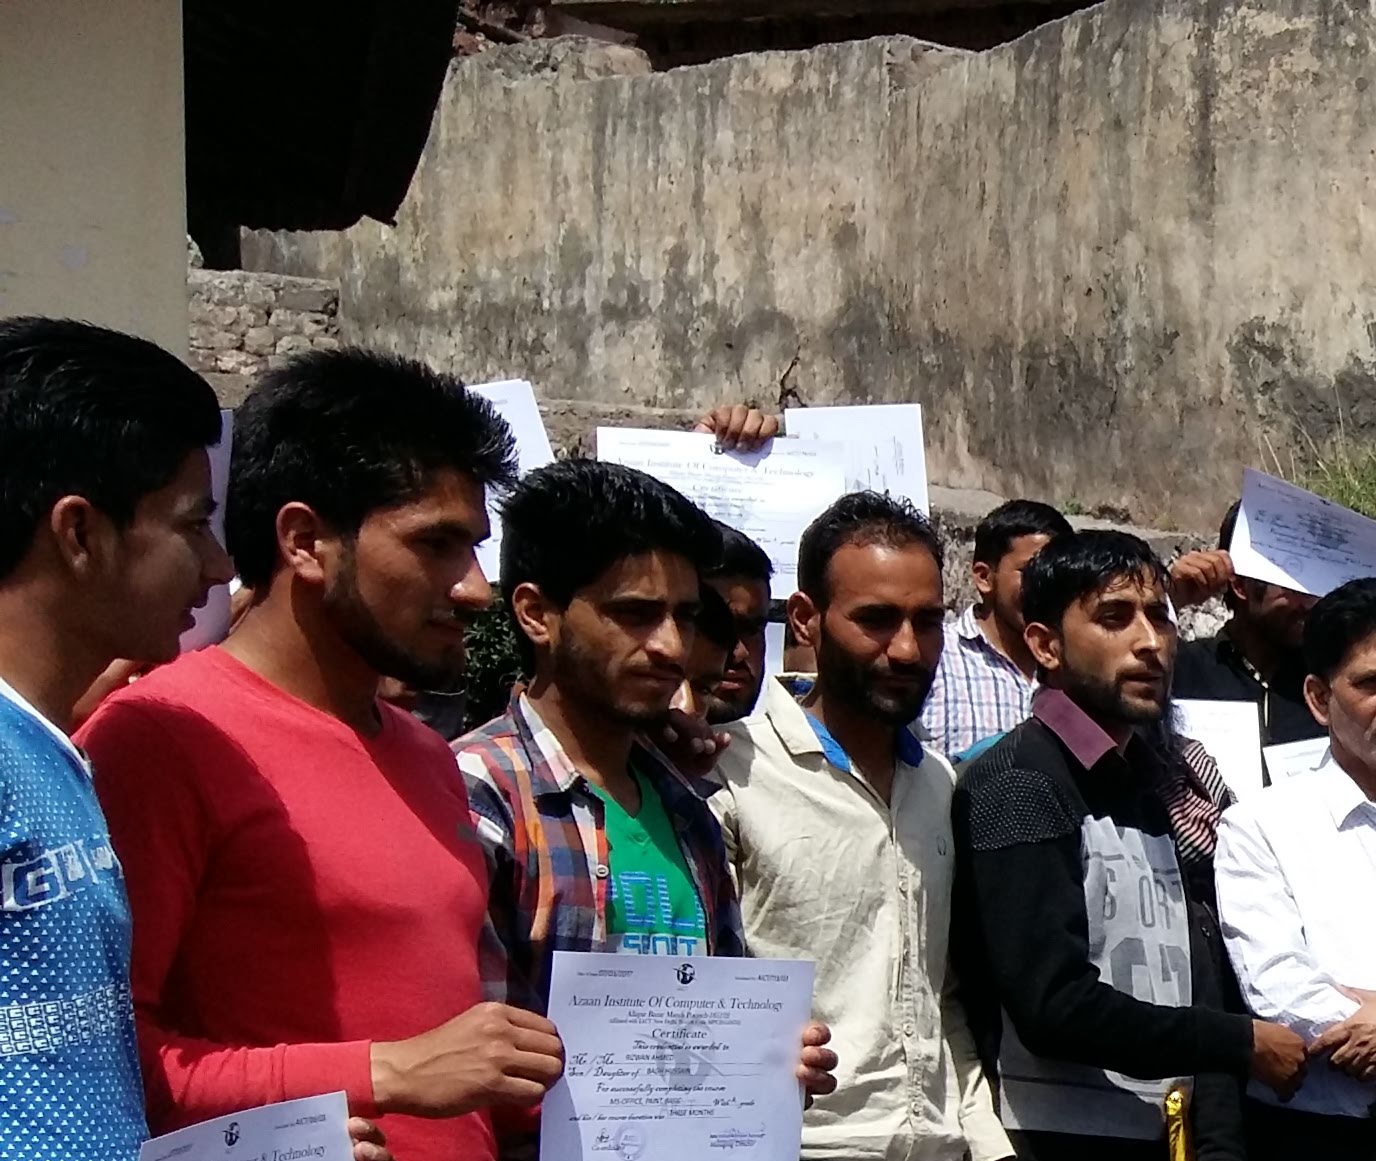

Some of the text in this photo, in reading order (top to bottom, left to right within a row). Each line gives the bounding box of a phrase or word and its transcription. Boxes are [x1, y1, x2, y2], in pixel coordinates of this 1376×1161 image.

[604, 994, 645, 1008] Institute
[648, 995, 663, 1008] Of
[665, 996, 715, 1011] Computer
[717, 999, 725, 1009] &
[730, 998, 783, 1012] Technology
[651, 1029, 707, 1038] Certificate
